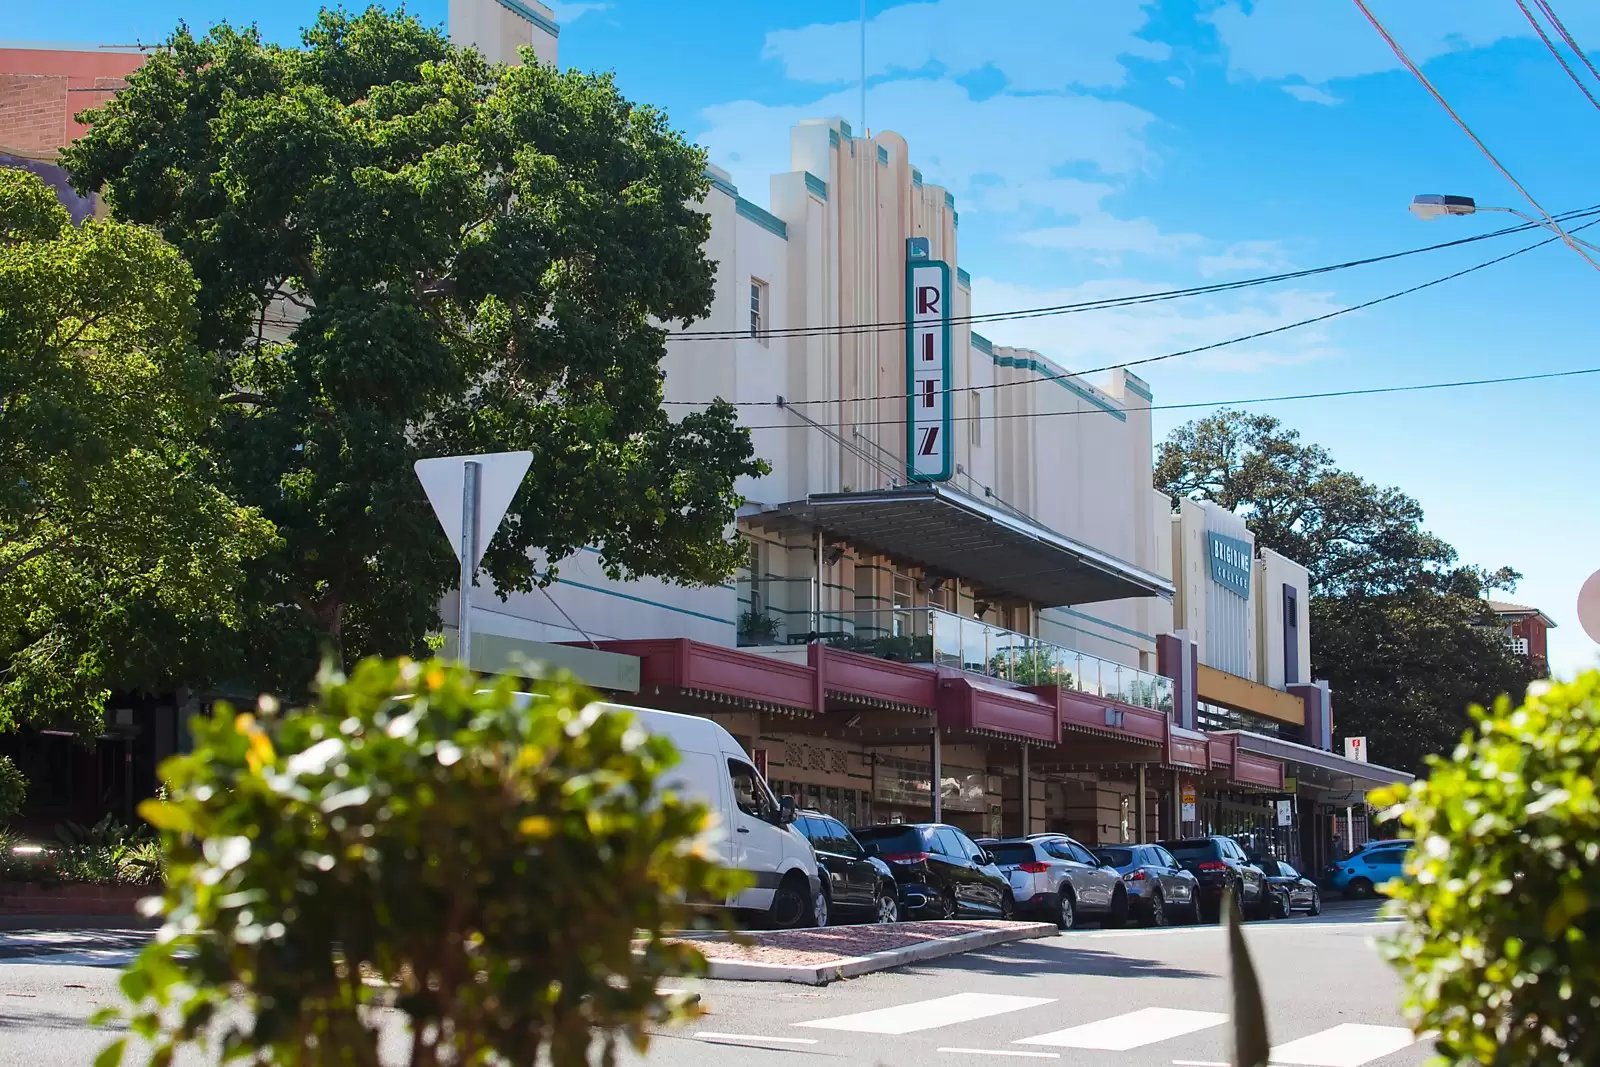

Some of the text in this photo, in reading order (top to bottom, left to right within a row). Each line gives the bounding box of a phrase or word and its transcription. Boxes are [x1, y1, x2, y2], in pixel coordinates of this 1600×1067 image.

[915, 286, 940, 456] RITZ
[1214, 540, 1249, 572] BRIGIDINE
[1217, 566, 1247, 589] COLLEGE
